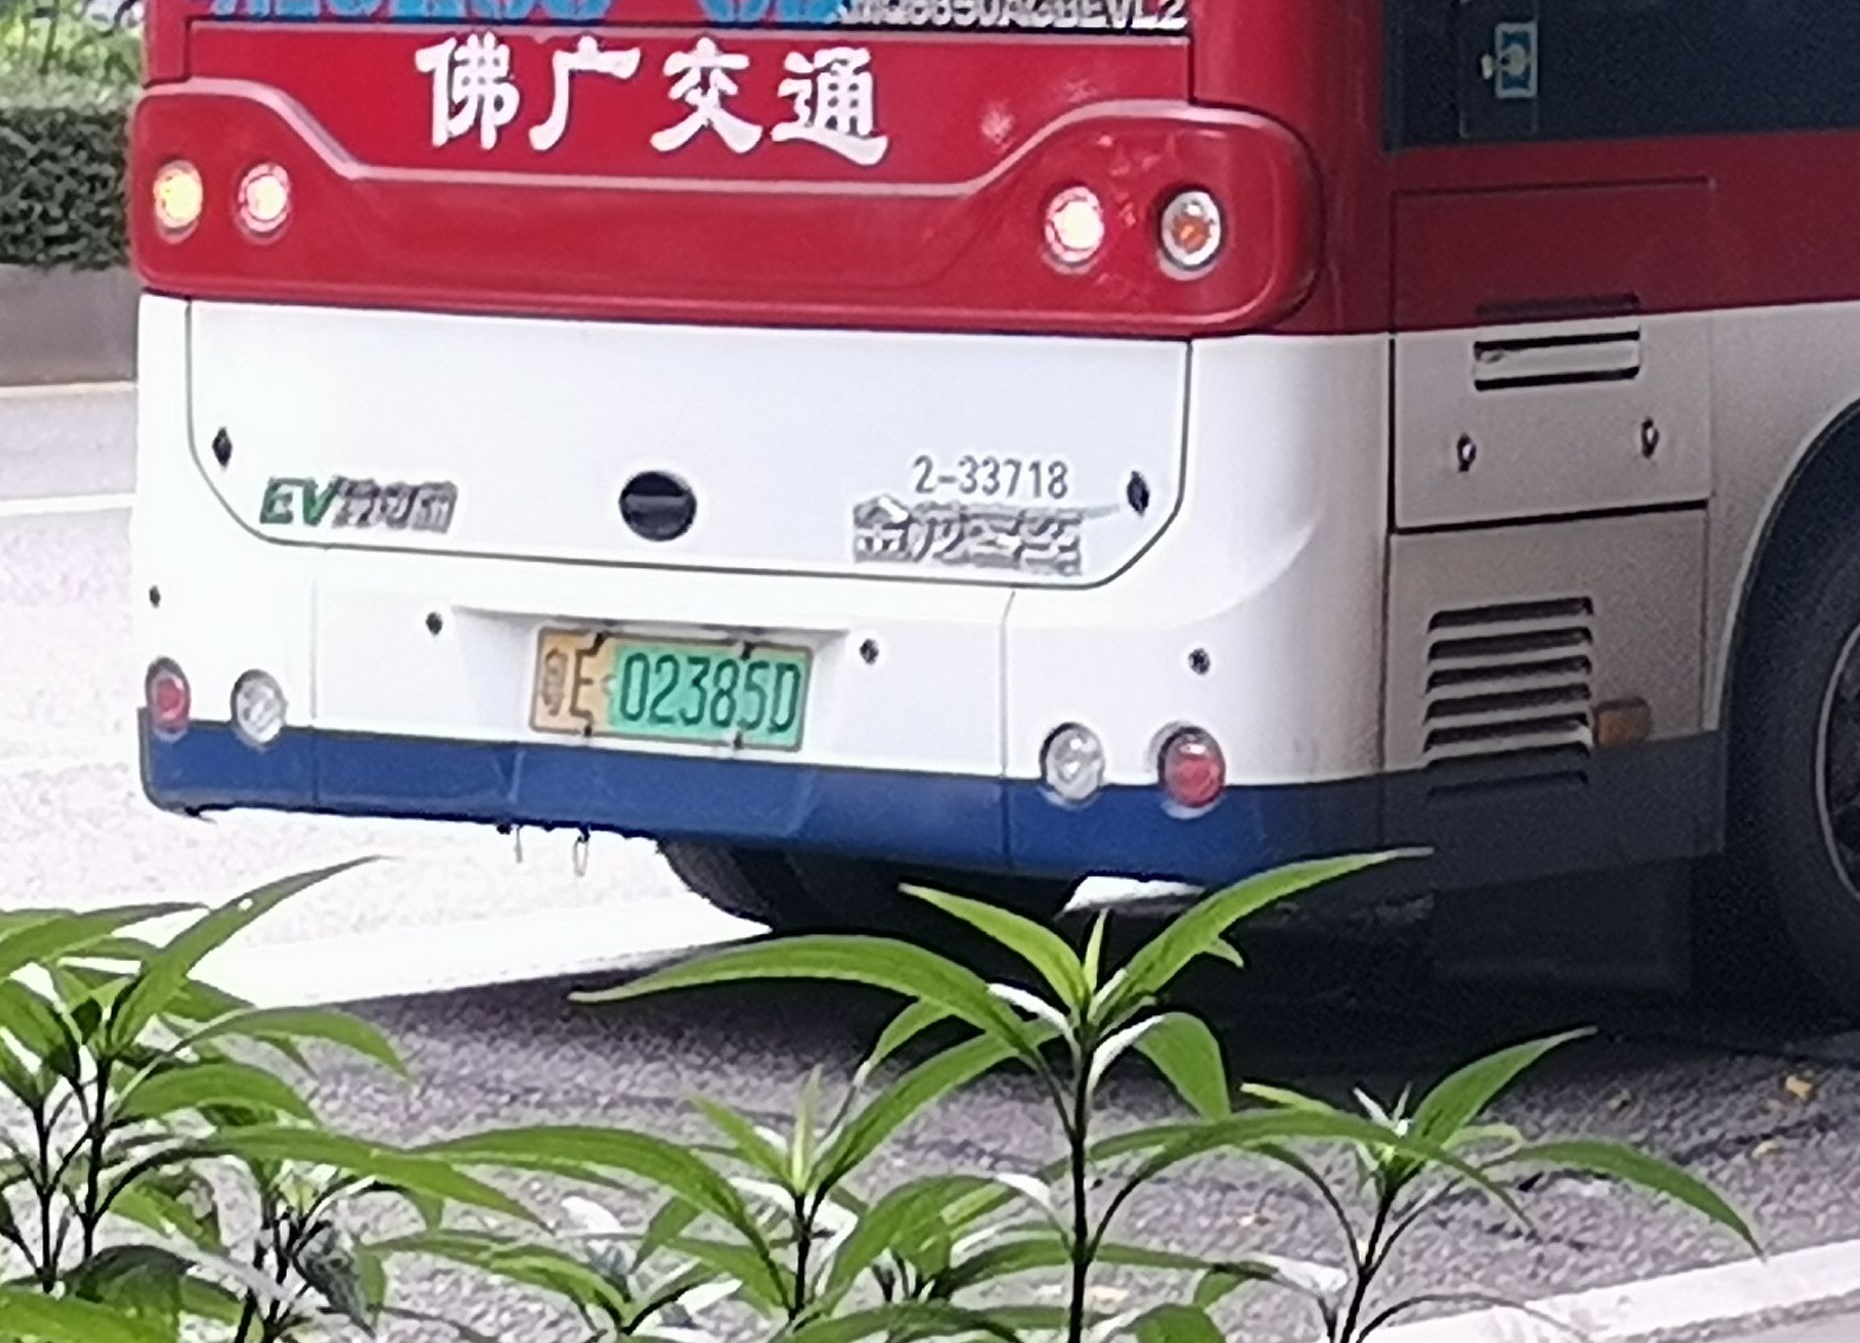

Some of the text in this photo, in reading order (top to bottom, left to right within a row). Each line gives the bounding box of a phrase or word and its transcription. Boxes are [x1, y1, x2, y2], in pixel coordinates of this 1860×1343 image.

[415, 31, 889, 166] 佛广交通
[913, 454, 1069, 500] 2-33718
